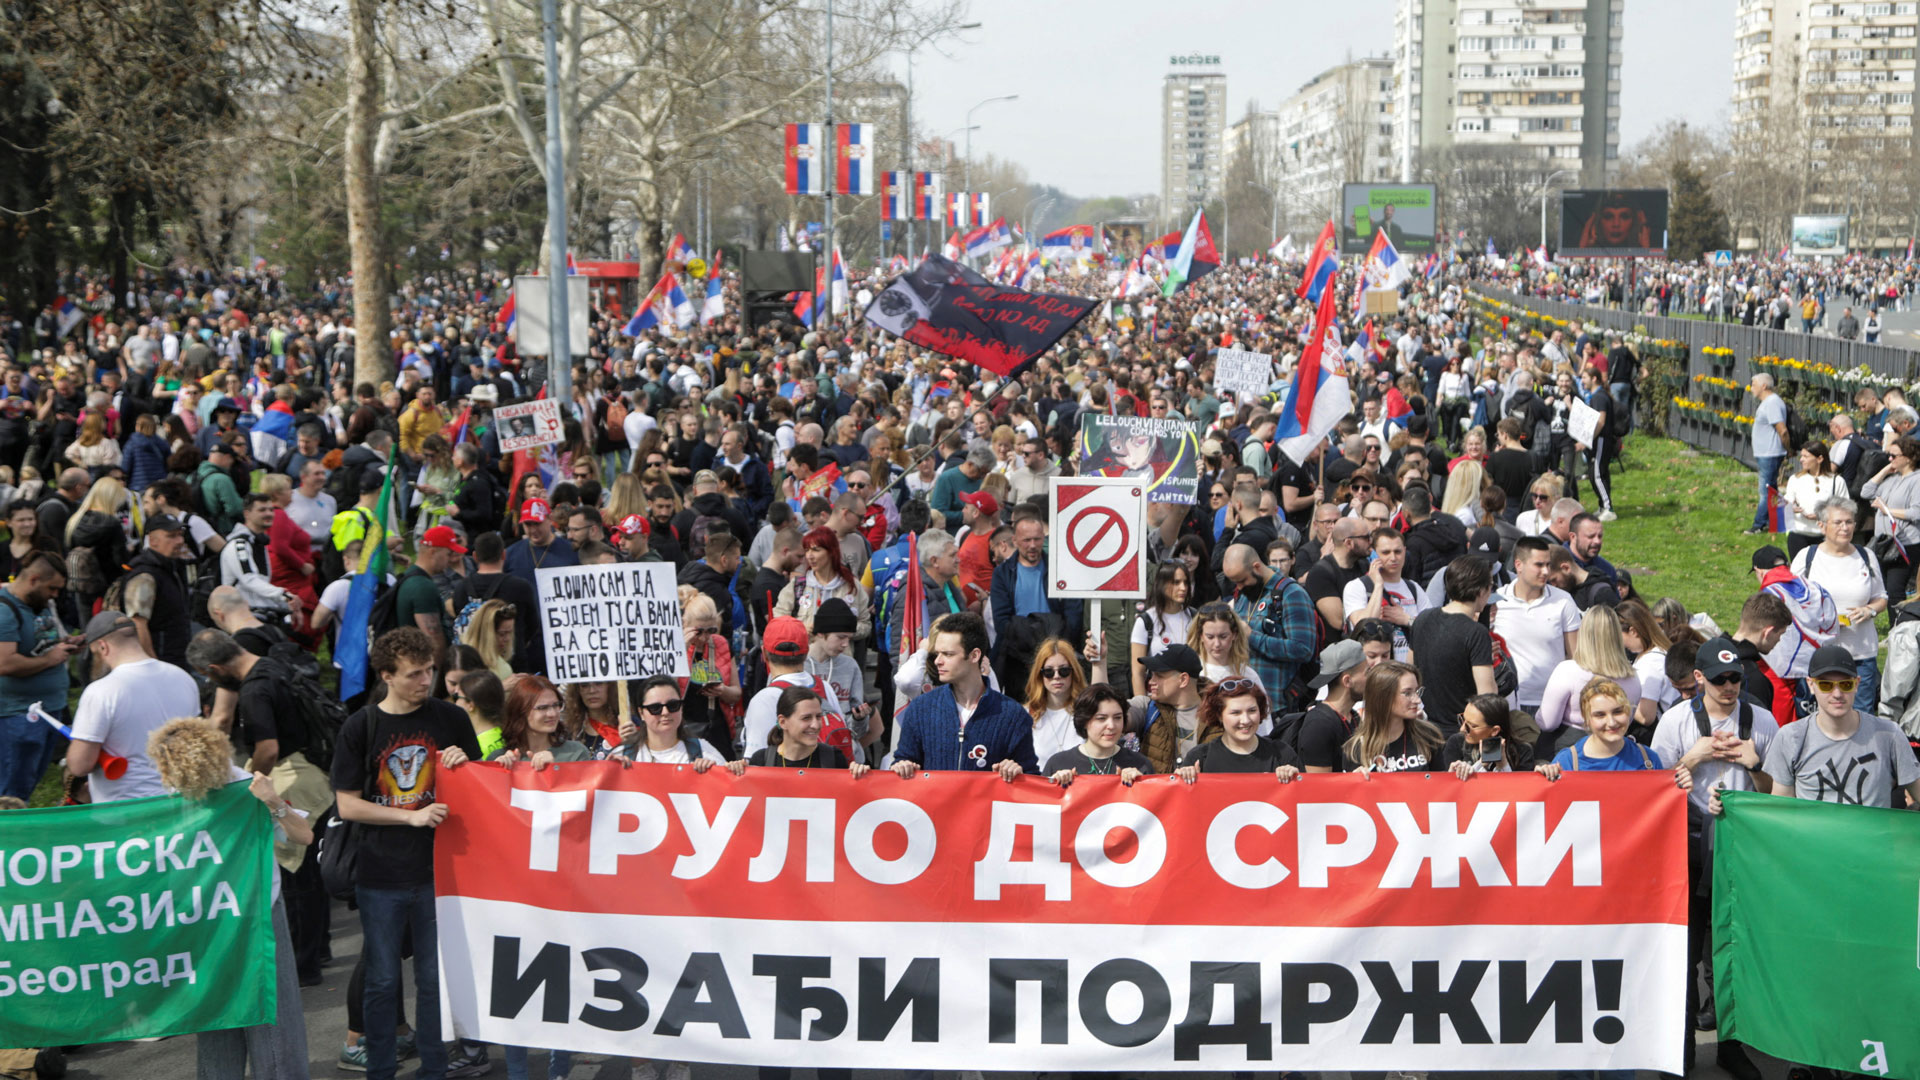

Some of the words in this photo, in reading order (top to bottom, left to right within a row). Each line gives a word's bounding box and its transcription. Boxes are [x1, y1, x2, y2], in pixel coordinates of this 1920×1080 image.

[599, 571, 626, 597] САМ
[632, 569, 655, 598] ДА
[547, 603, 600, 628] БУДЕМ
[647, 600, 681, 627] ВАМА
[552, 630, 580, 653] ДА
[588, 628, 609, 651] СЕ
[618, 628, 637, 652] НЕ
[641, 628, 676, 653] ДЕСИ
[554, 652, 609, 680] НЕШТО
[510, 787, 938, 885] ТРУЛО
[974, 800, 1168, 901] ДО
[1205, 800, 1603, 890] СРЖИ
[489, 934, 941, 1043] ИЗАЂИ
[988, 957, 1625, 1062] ПОДРЖИ!
